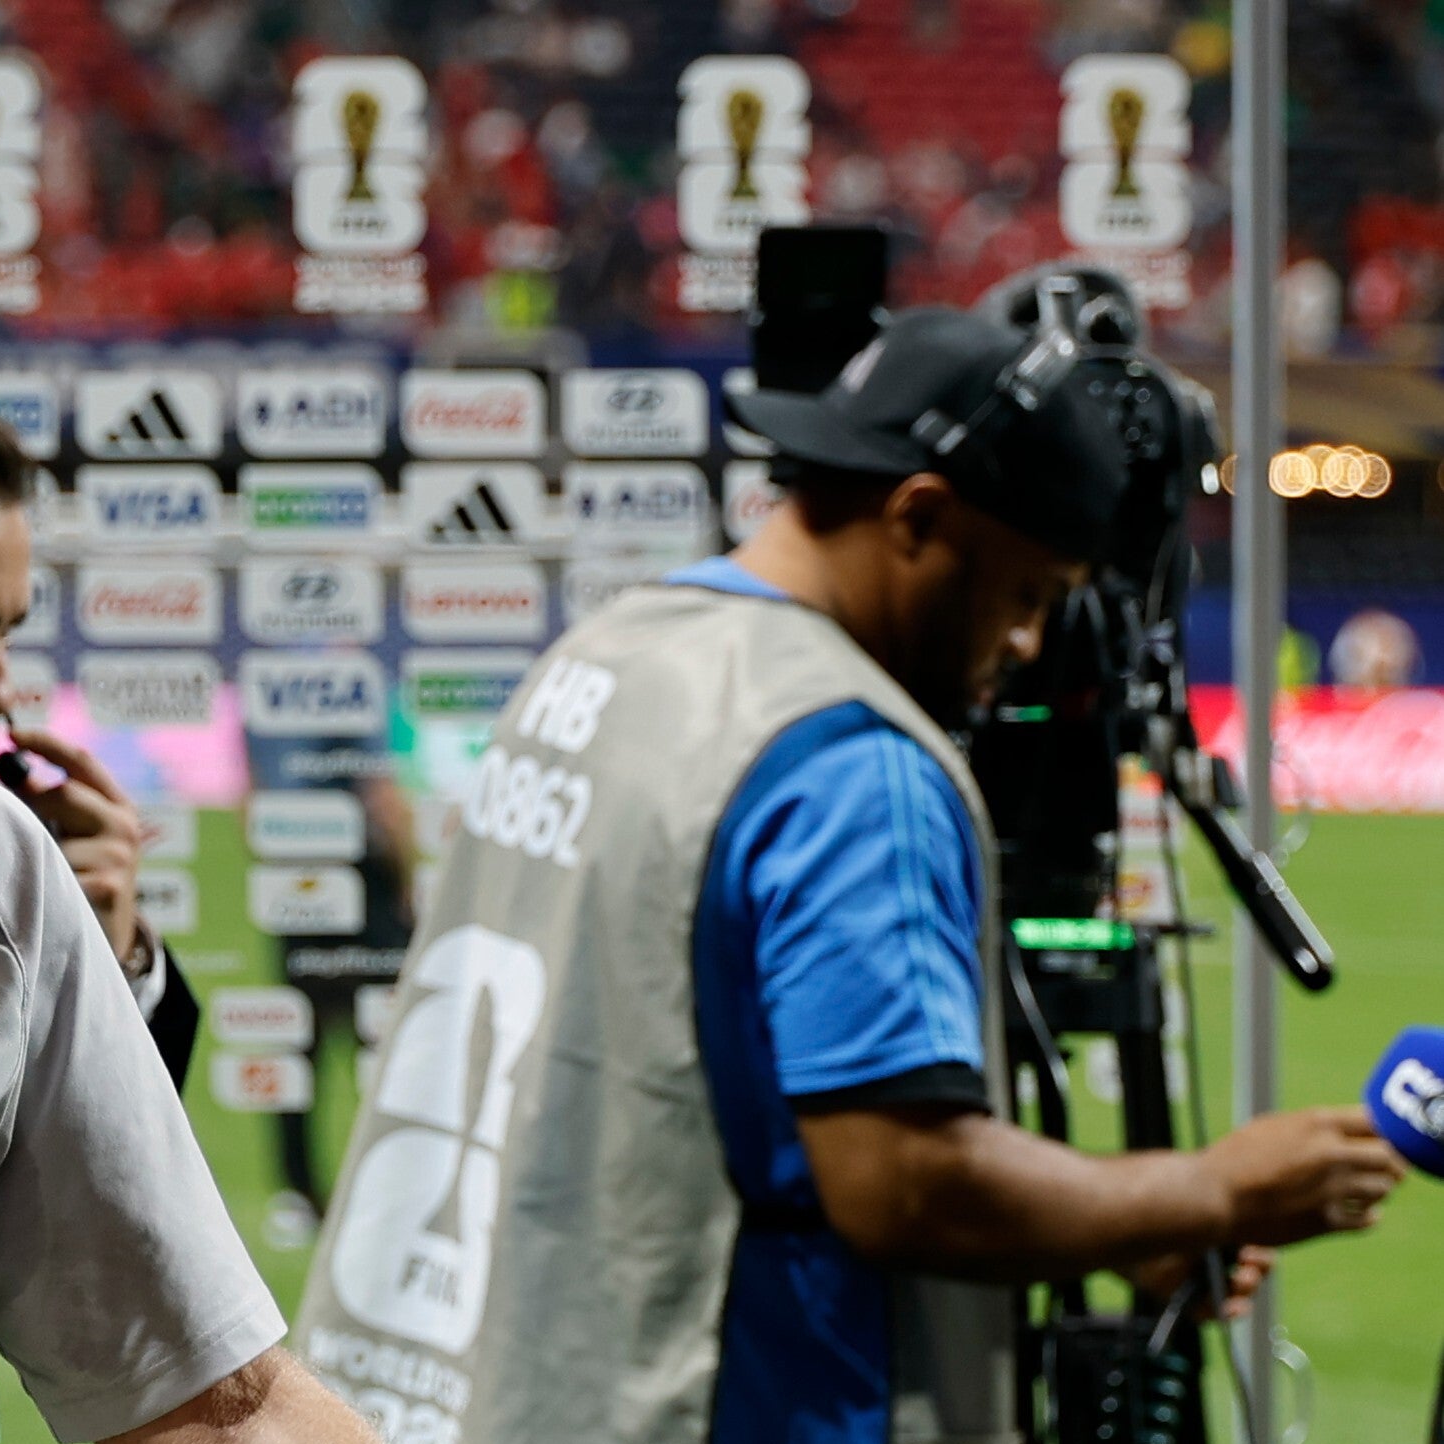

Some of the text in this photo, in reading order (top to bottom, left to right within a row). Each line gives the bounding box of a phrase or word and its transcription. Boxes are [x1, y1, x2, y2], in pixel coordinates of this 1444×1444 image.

[95, 487, 208, 527] VISA
[257, 671, 372, 711] VISA
[517, 655, 617, 753] HB
[462, 744, 593, 868] 0862
